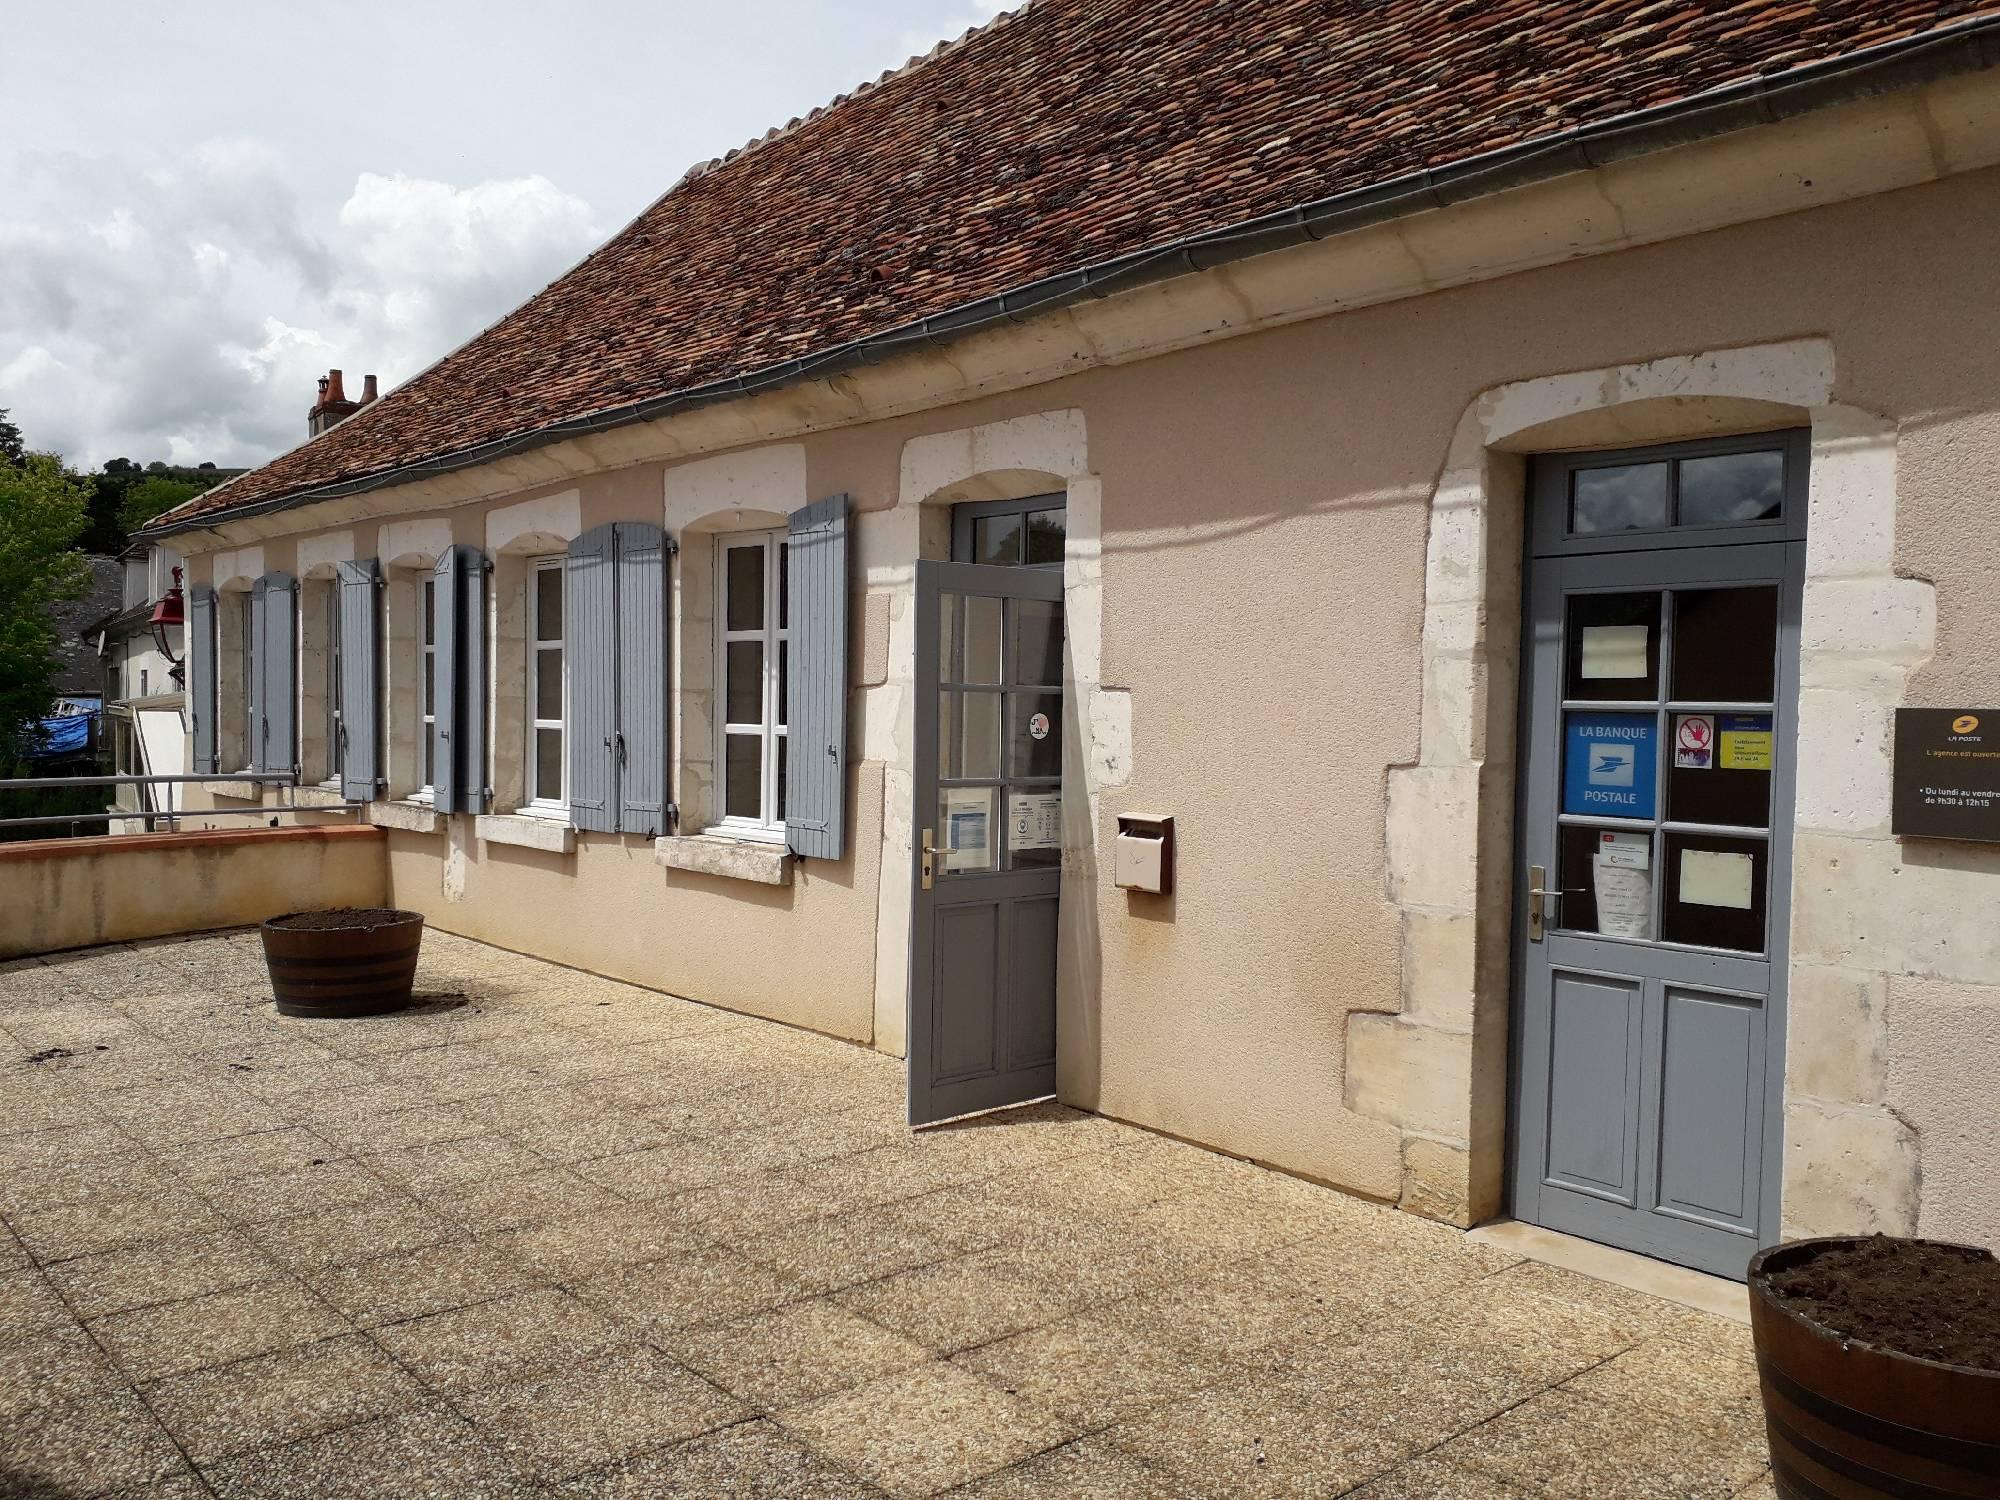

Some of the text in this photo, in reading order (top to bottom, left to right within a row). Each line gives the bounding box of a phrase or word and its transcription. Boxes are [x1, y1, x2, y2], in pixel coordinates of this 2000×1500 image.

[1580, 726, 1648, 740] LA BANQUE
[1584, 790, 1637, 804] POSTALE
[1925, 787, 1937, 795] Du
[1938, 787, 1959, 796] lundi
[1957, 798, 1963, 806] à
[1966, 798, 1990, 807] 12h15
